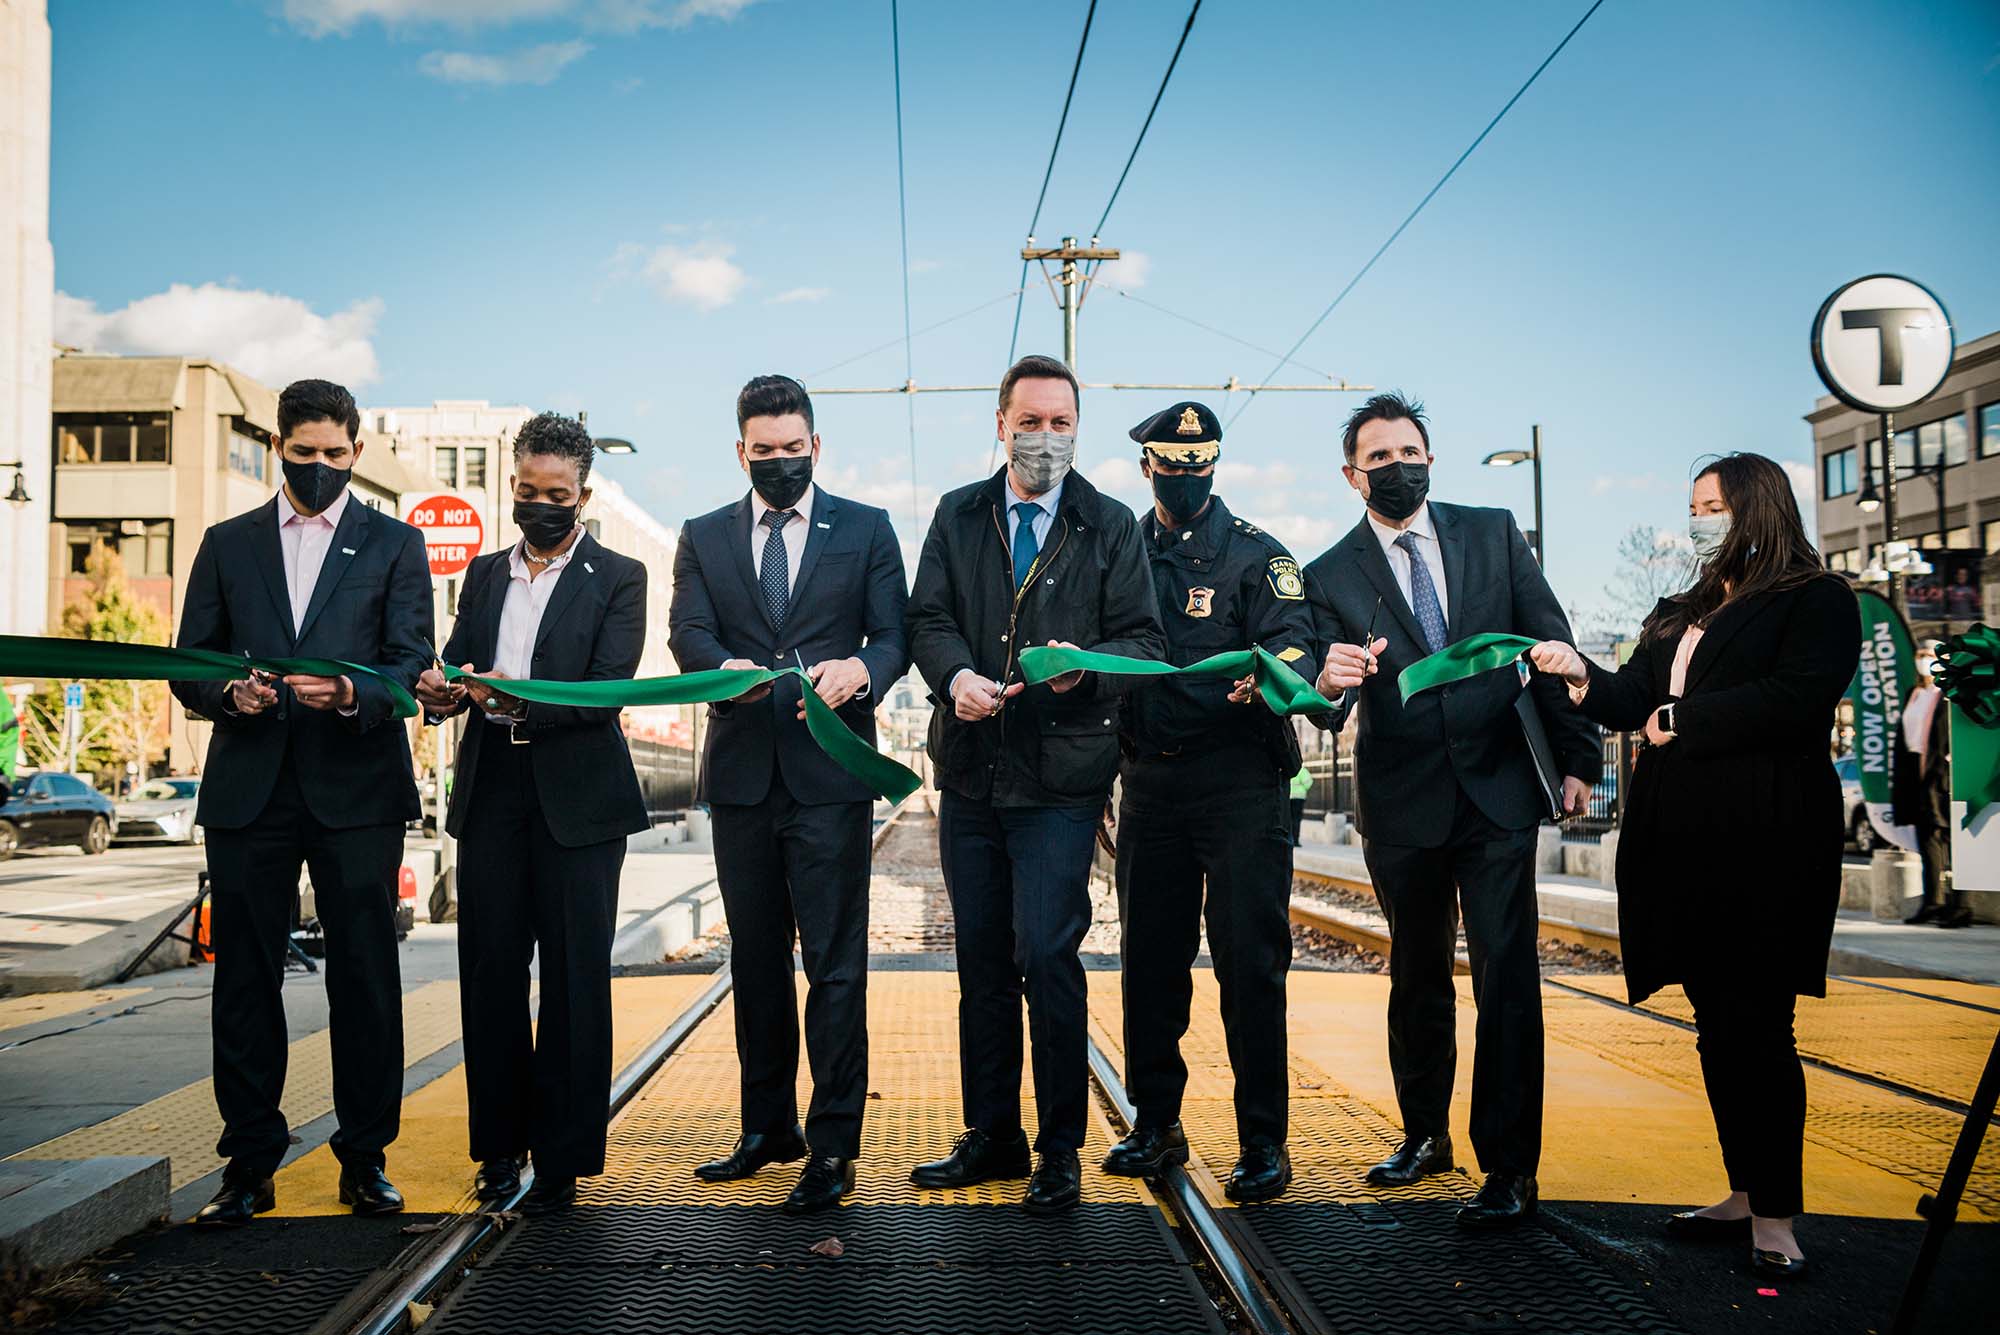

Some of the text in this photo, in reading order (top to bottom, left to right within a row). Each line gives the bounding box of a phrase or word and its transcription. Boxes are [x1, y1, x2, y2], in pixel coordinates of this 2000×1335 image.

[1840, 308, 1932, 385] T
[414, 509, 473, 525] DO NOT
[427, 546, 467, 561] NTER
[1861, 640, 1885, 773] NOW OPEN
[1874, 622, 1900, 724] STATION
